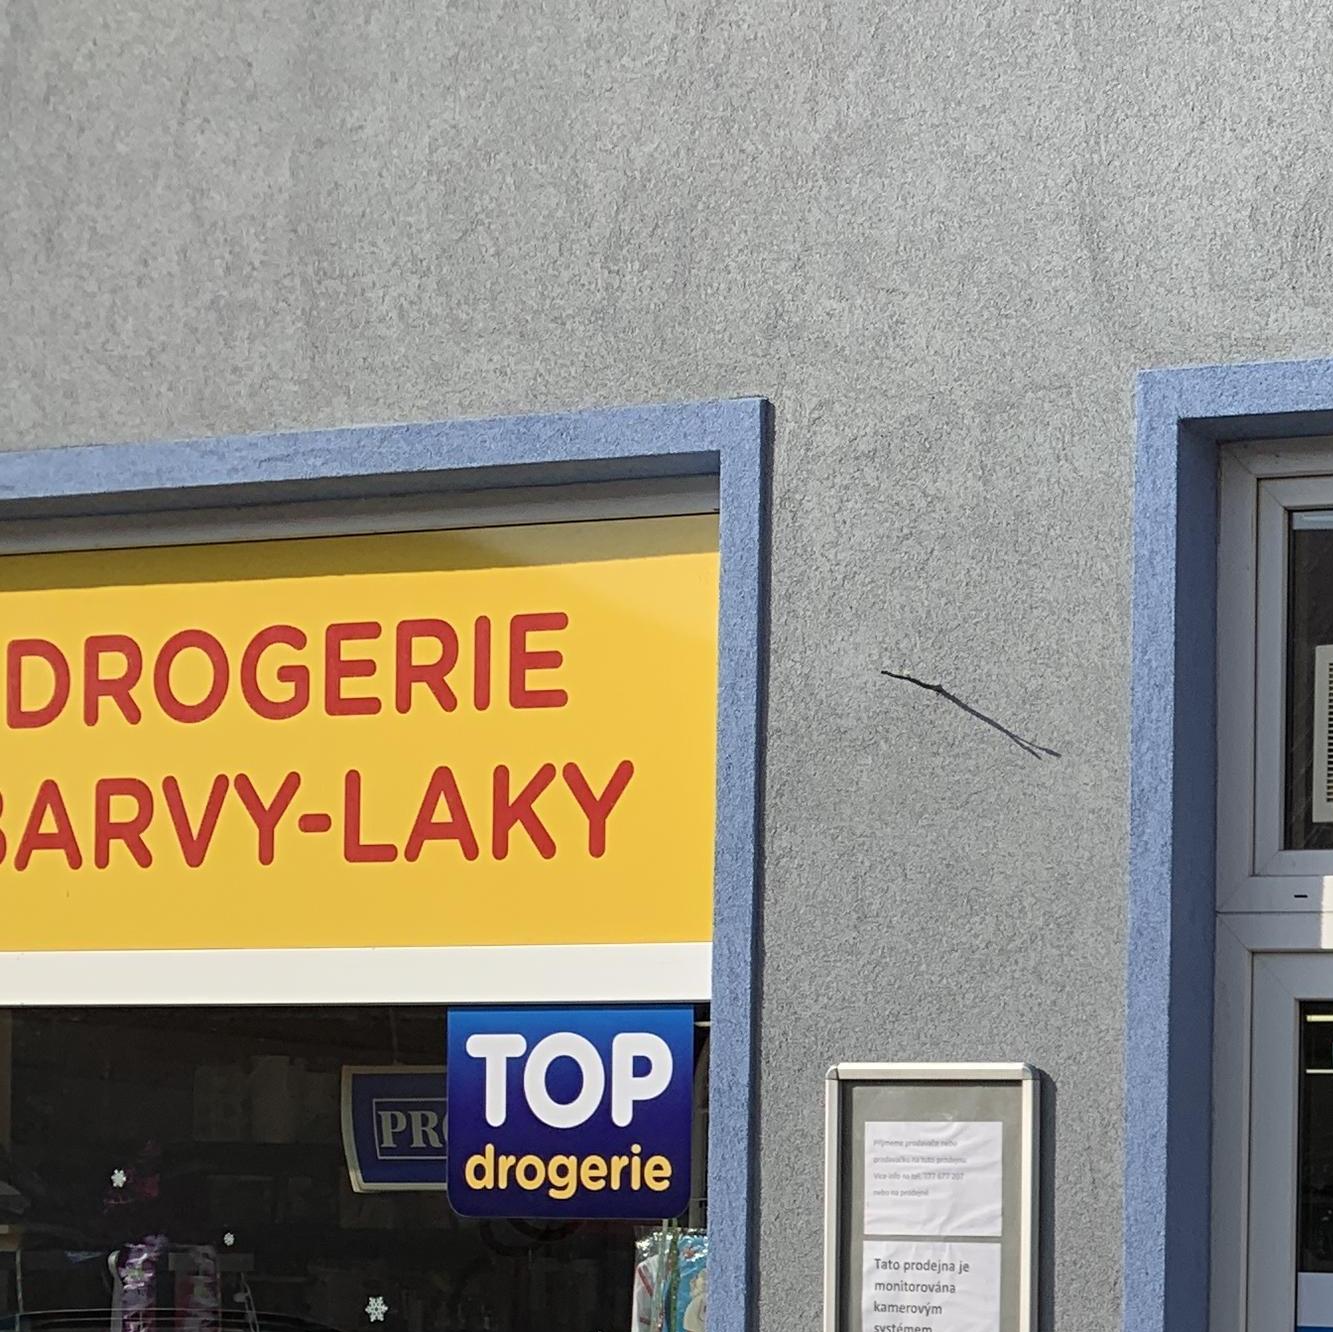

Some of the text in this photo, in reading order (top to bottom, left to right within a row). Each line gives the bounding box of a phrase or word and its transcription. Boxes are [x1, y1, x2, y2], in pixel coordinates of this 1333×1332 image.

[6, 611, 570, 729] DROGERIE
[0, 759, 635, 871] ARVY-LAKY
[466, 1031, 674, 1129] TOP
[377, 1111, 448, 1148] PR
[466, 1144, 673, 1200] drogerie
[874, 1258, 970, 1275] Tato prodejna je
[874, 1280, 956, 1293] monitorována
[873, 1300, 943, 1317] kamerovým
